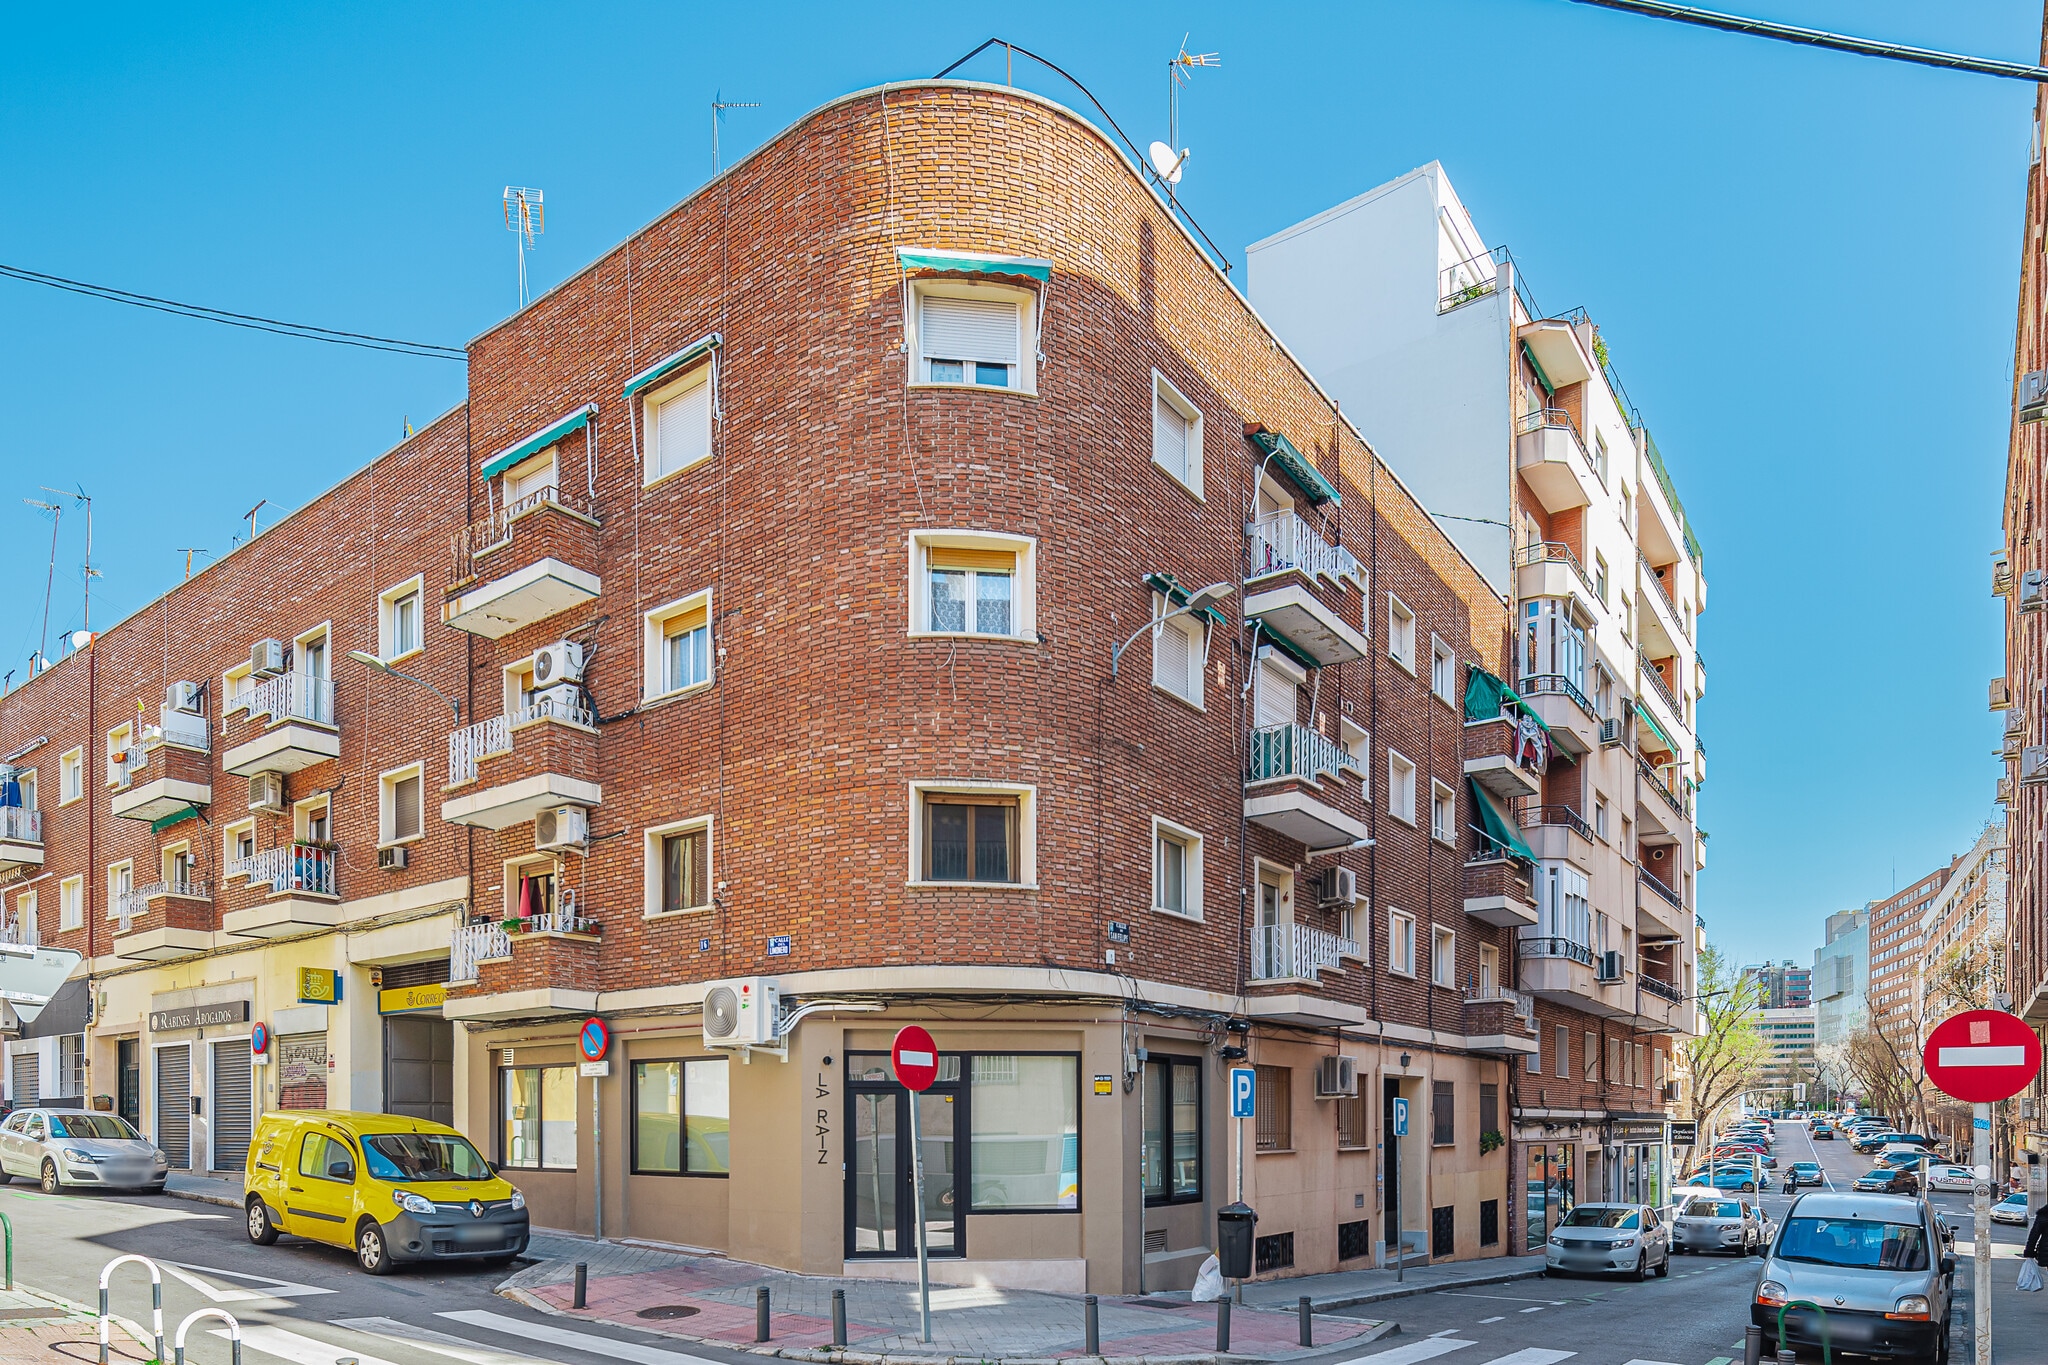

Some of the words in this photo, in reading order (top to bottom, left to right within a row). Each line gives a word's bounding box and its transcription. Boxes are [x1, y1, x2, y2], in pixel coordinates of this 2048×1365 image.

[700, 941, 707, 949] 16
[161, 1013, 190, 1029] RABINES
[194, 1009, 232, 1025] ABOGADOS
[816, 1073, 830, 1098] LA
[1237, 1074, 1251, 1112] P
[1397, 1103, 1406, 1131] P
[816, 1109, 830, 1164] RAIZ
